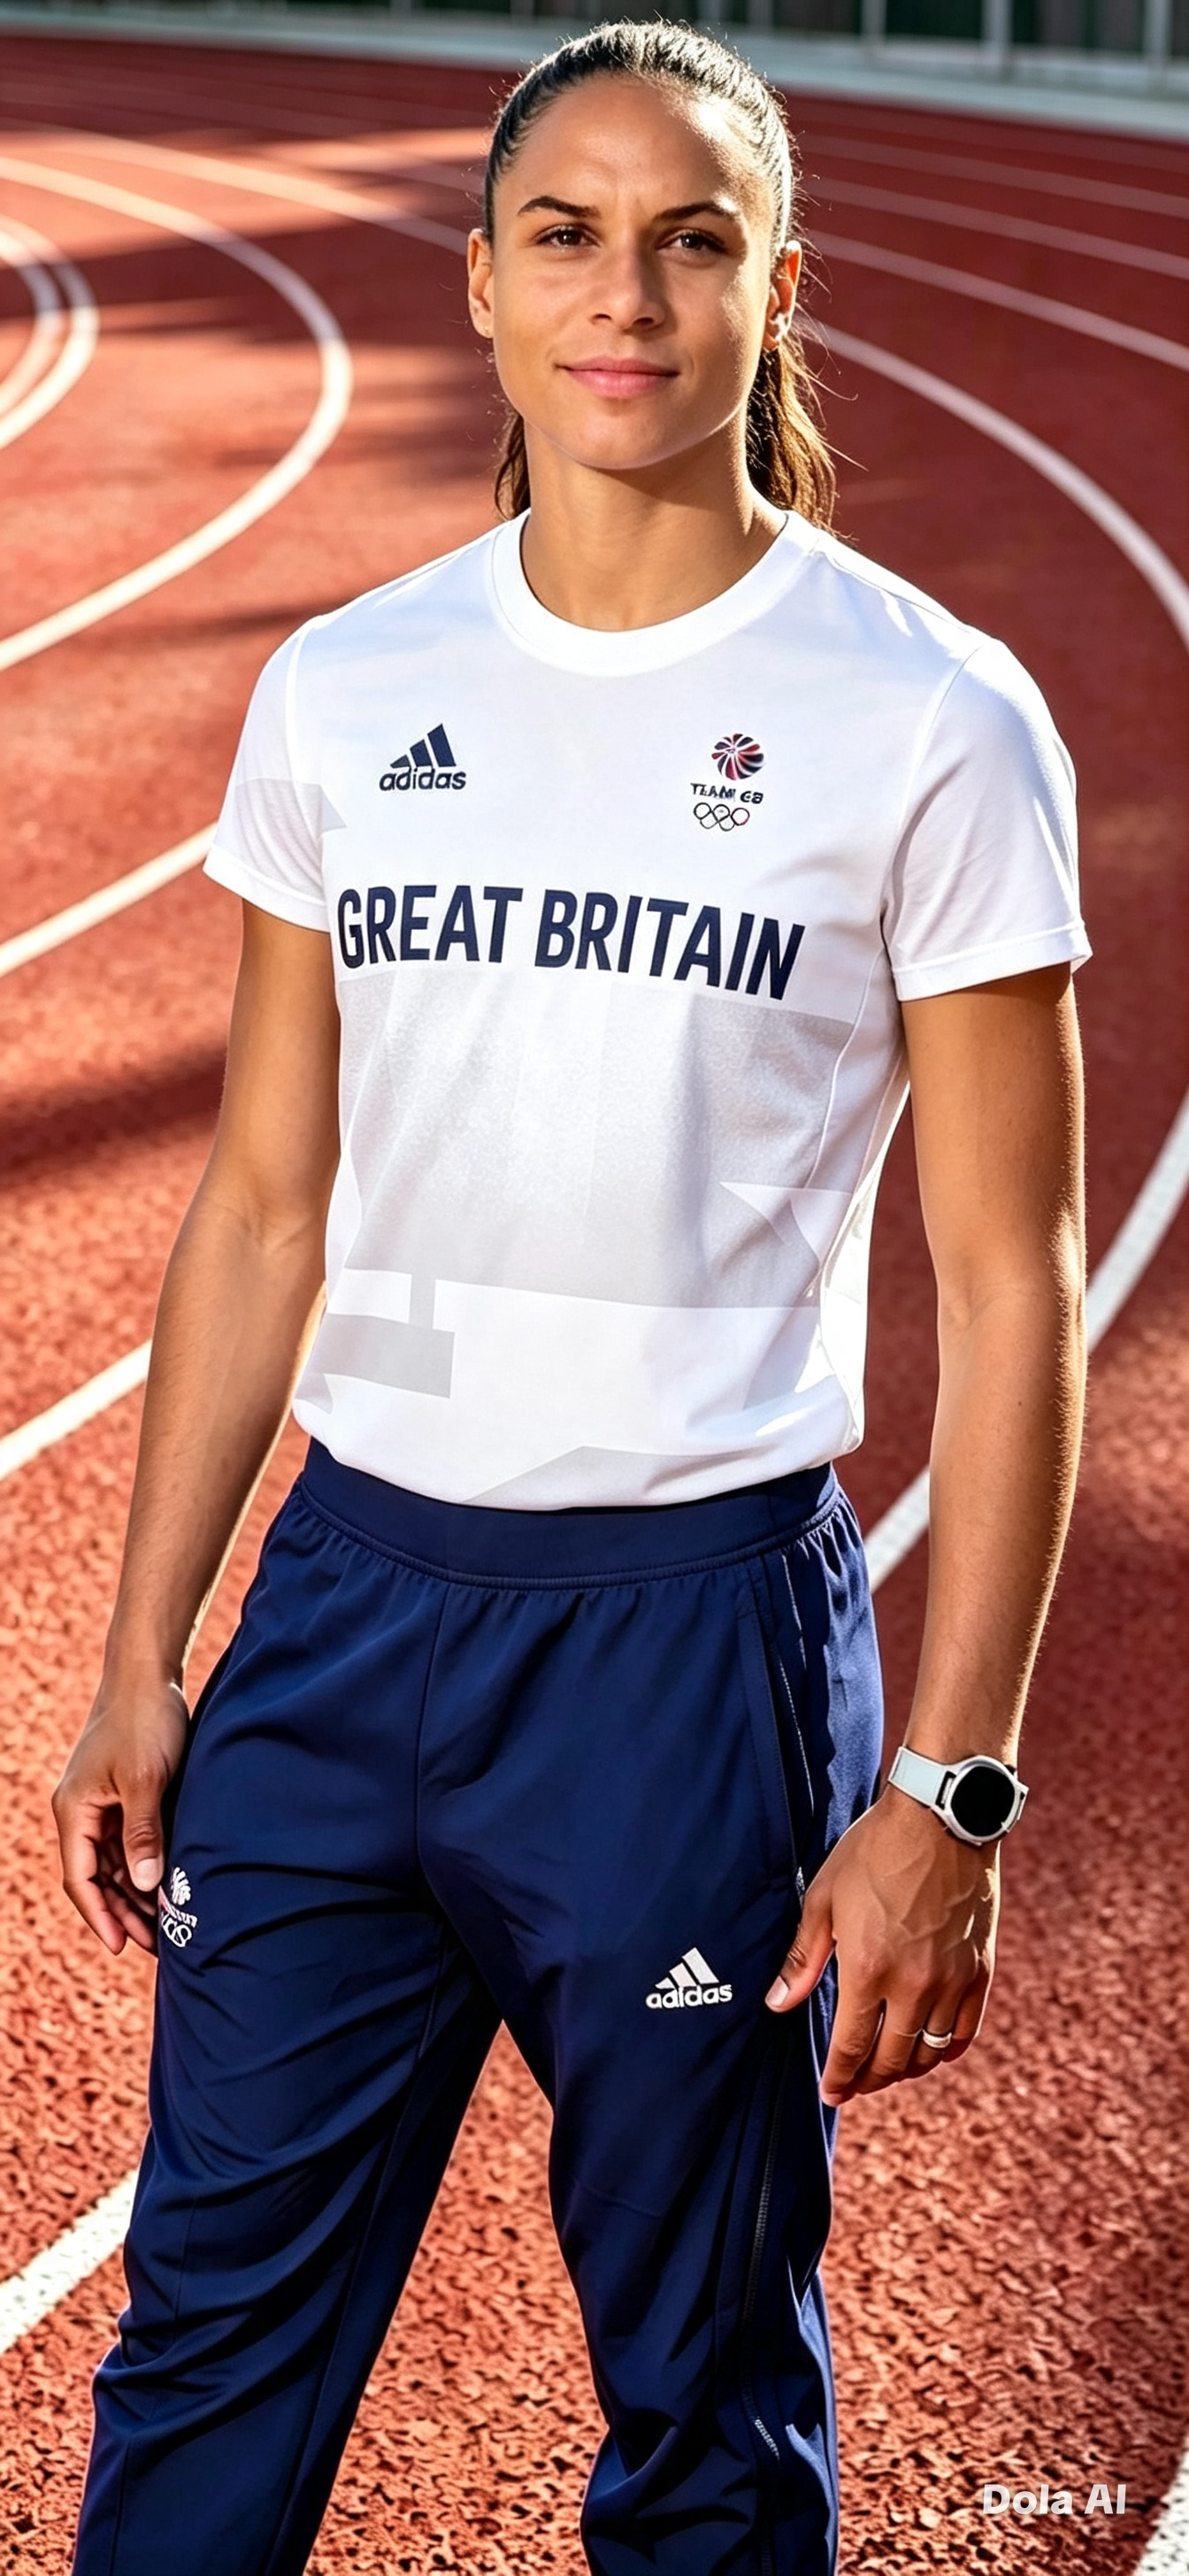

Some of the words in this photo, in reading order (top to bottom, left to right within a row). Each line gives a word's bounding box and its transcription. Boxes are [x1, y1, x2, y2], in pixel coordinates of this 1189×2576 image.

[379, 766, 467, 791] adidas
[337, 885, 524, 970] GREAT
[533, 888, 806, 1000] BRITAIN
[645, 1984, 733, 2009] adidas
